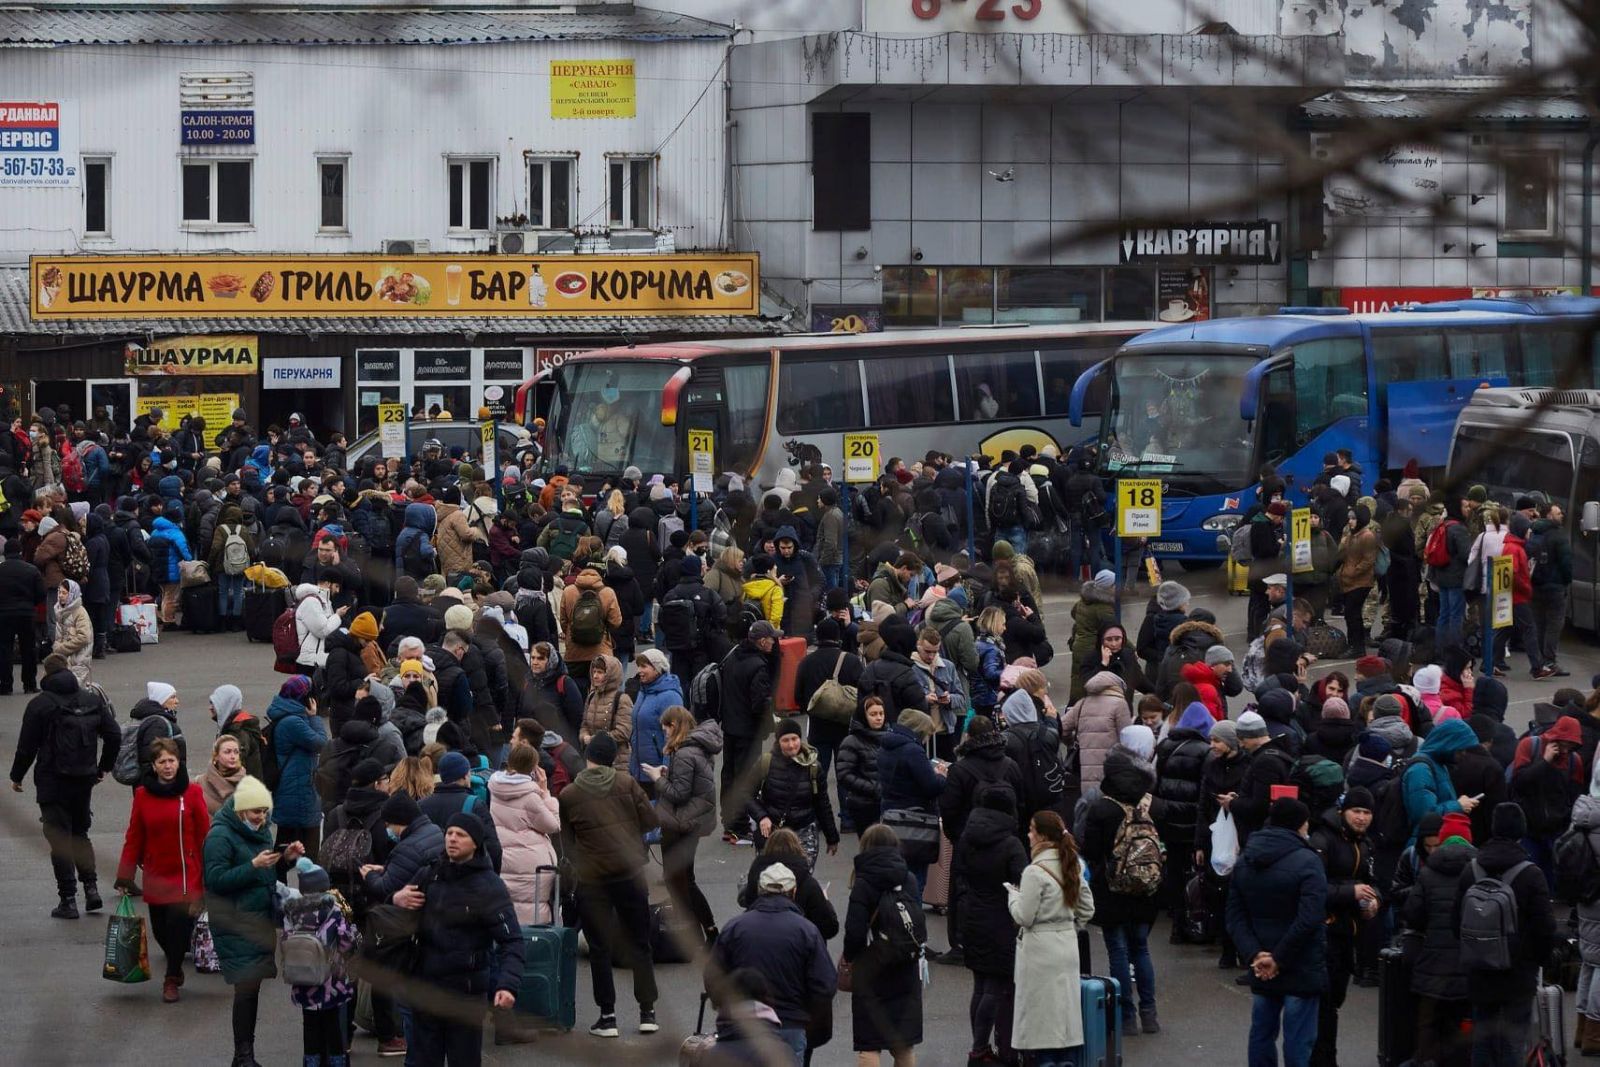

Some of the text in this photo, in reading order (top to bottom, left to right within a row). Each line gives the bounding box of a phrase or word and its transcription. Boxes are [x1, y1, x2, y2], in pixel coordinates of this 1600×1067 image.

[552, 65, 634, 76] ПЕРУКАРНЯ
[183, 116, 253, 126] САЛОН-КРАСИ
[0, 131, 53, 148] ЕРВІС
[187, 130, 214, 139] 10.00
[222, 130, 250, 139] 20.00
[67, 269, 714, 303] ШАУРМА ГРИЛЬ БАР КОРЧМА
[138, 348, 253, 366] ШАУРМА
[273, 368, 333, 379] ПЕРУКАРНЯ
[384, 409, 405, 423] 23
[484, 427, 494, 442] 22
[693, 436, 709, 452] 21
[851, 441, 874, 457] 20
[1127, 488, 1155, 507] 18
[1295, 518, 1308, 540] 17
[1496, 566, 1510, 591] 16
